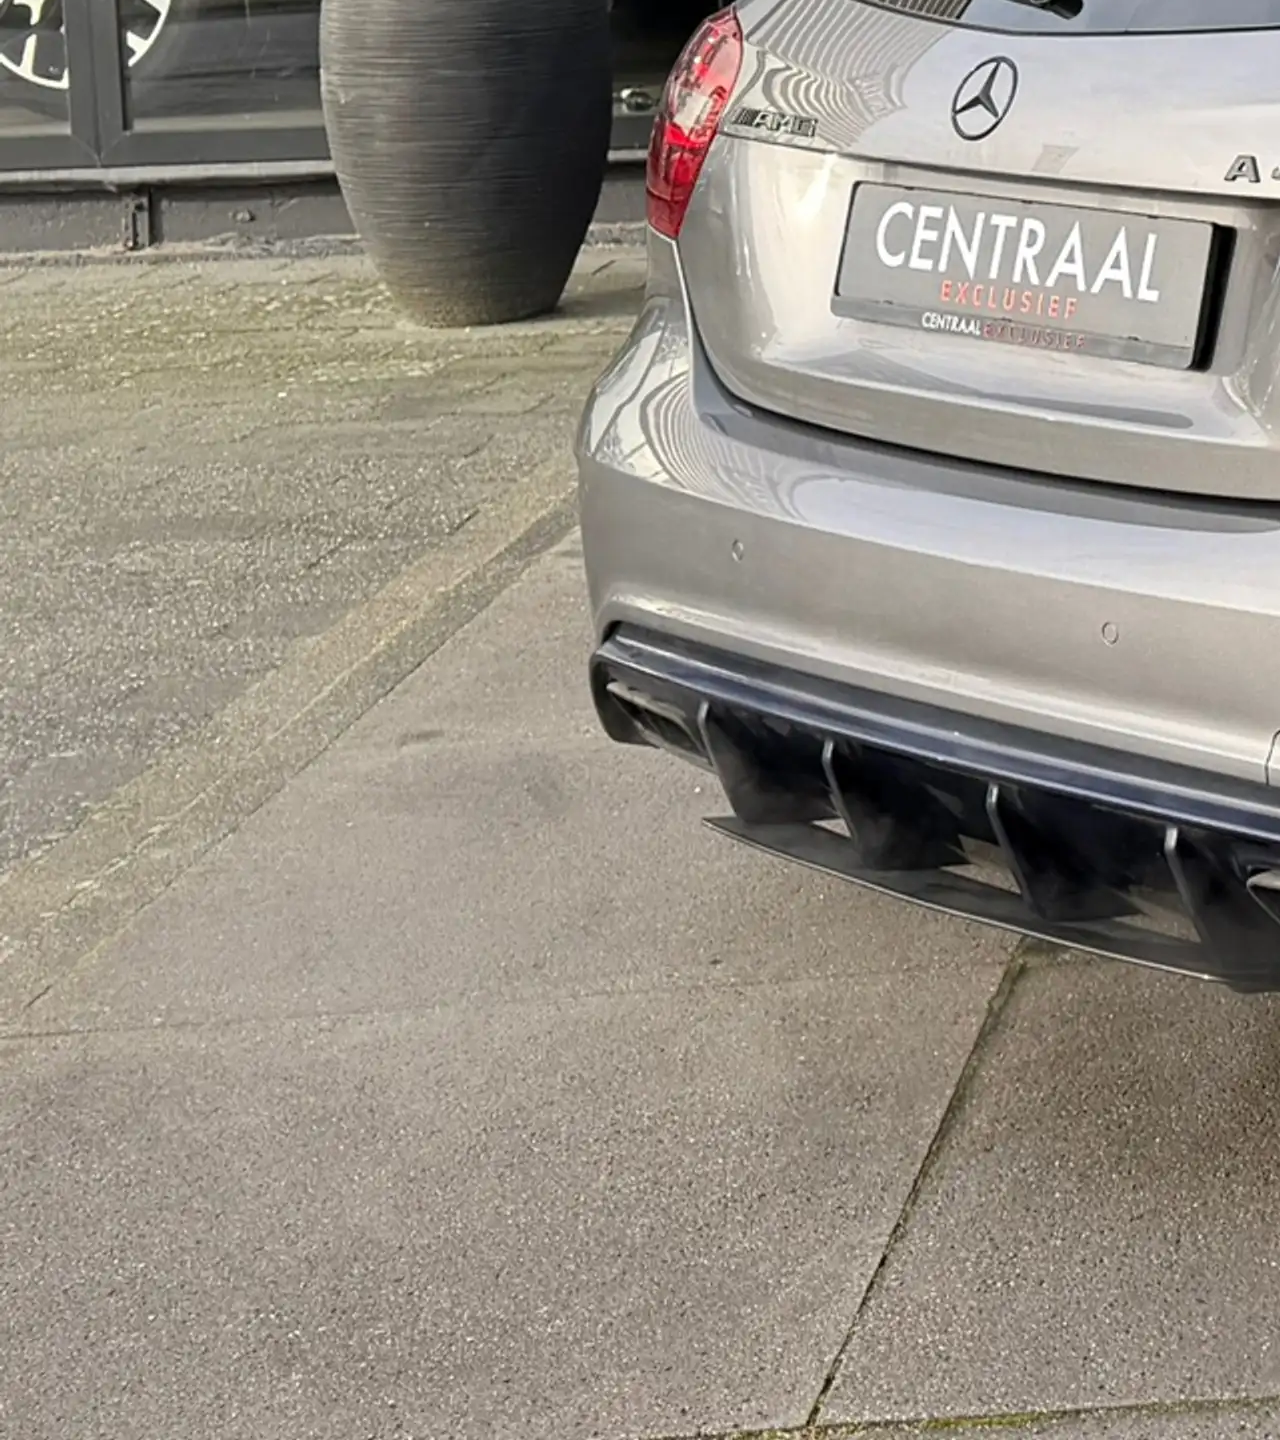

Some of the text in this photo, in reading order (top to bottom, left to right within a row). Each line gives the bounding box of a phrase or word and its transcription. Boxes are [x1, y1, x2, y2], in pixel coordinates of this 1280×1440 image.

[1223, 154, 1261, 183] A
[876, 201, 1160, 303] CENTRAAL
[939, 279, 1078, 320] EXCLUSIEF
[922, 312, 981, 336] CENTRAAL
